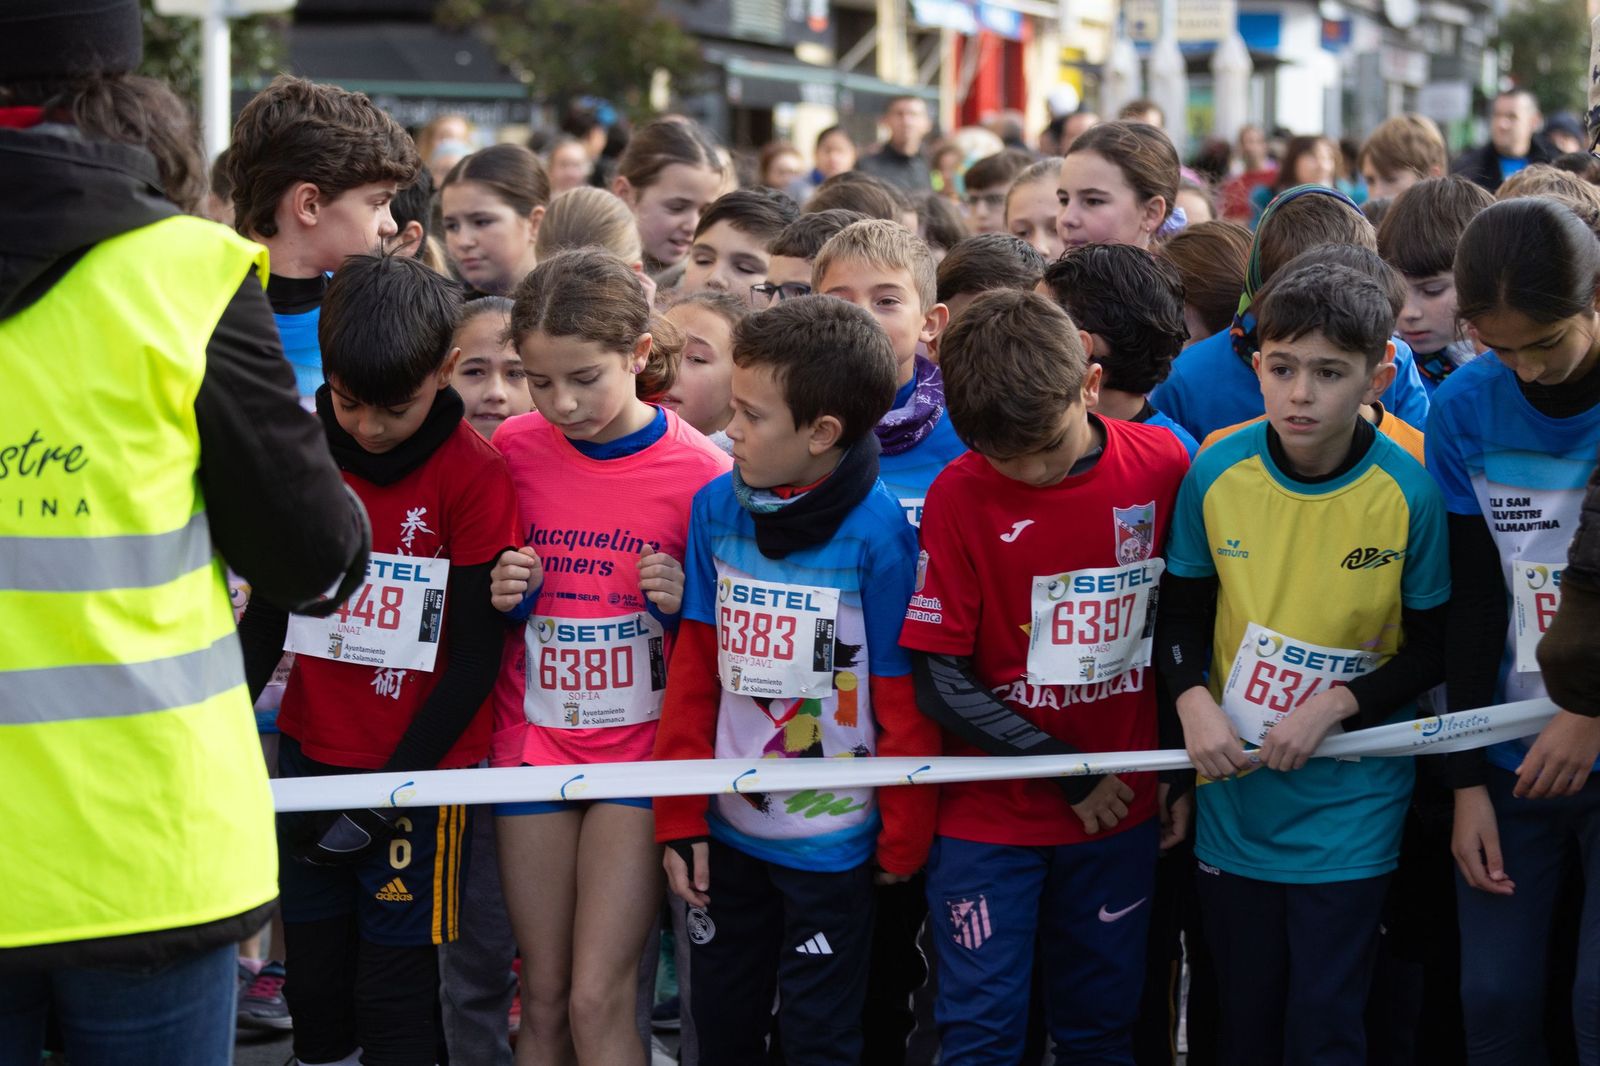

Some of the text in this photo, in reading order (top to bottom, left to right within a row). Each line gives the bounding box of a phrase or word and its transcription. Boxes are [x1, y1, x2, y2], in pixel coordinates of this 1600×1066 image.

[1506, 497, 1531, 507] SAN
[1492, 509, 1543, 520] ILVESTRE
[1495, 519, 1560, 532] ALMANTINA
[1217, 548, 1249, 559] amura
[366, 560, 430, 583] TEL
[541, 556, 614, 576] nners
[1074, 566, 1153, 594] SETEL
[577, 594, 600, 602] SEUR
[732, 584, 821, 612] SETEL
[318, 583, 404, 630] 448
[1052, 593, 1136, 645] 6397
[337, 624, 361, 636] UNAI
[557, 620, 650, 642] SETEL
[720, 606, 797, 660] 6383
[344, 644, 386, 655] Ayuntamiento
[1088, 643, 1109, 653] YAGO
[352, 653, 384, 664] Salamanca
[1283, 645, 1365, 673] SETEL
[540, 645, 634, 691] 6380
[743, 676, 782, 686] Ayuntamiento
[1244, 660, 1350, 713] 63
[750, 686, 782, 694] Salamanca
[568, 692, 601, 700] SOFIA
[582, 708, 625, 718] Ayuntamiento
[591, 716, 625, 725] Salamanca
[375, 891, 413, 902] adidas
